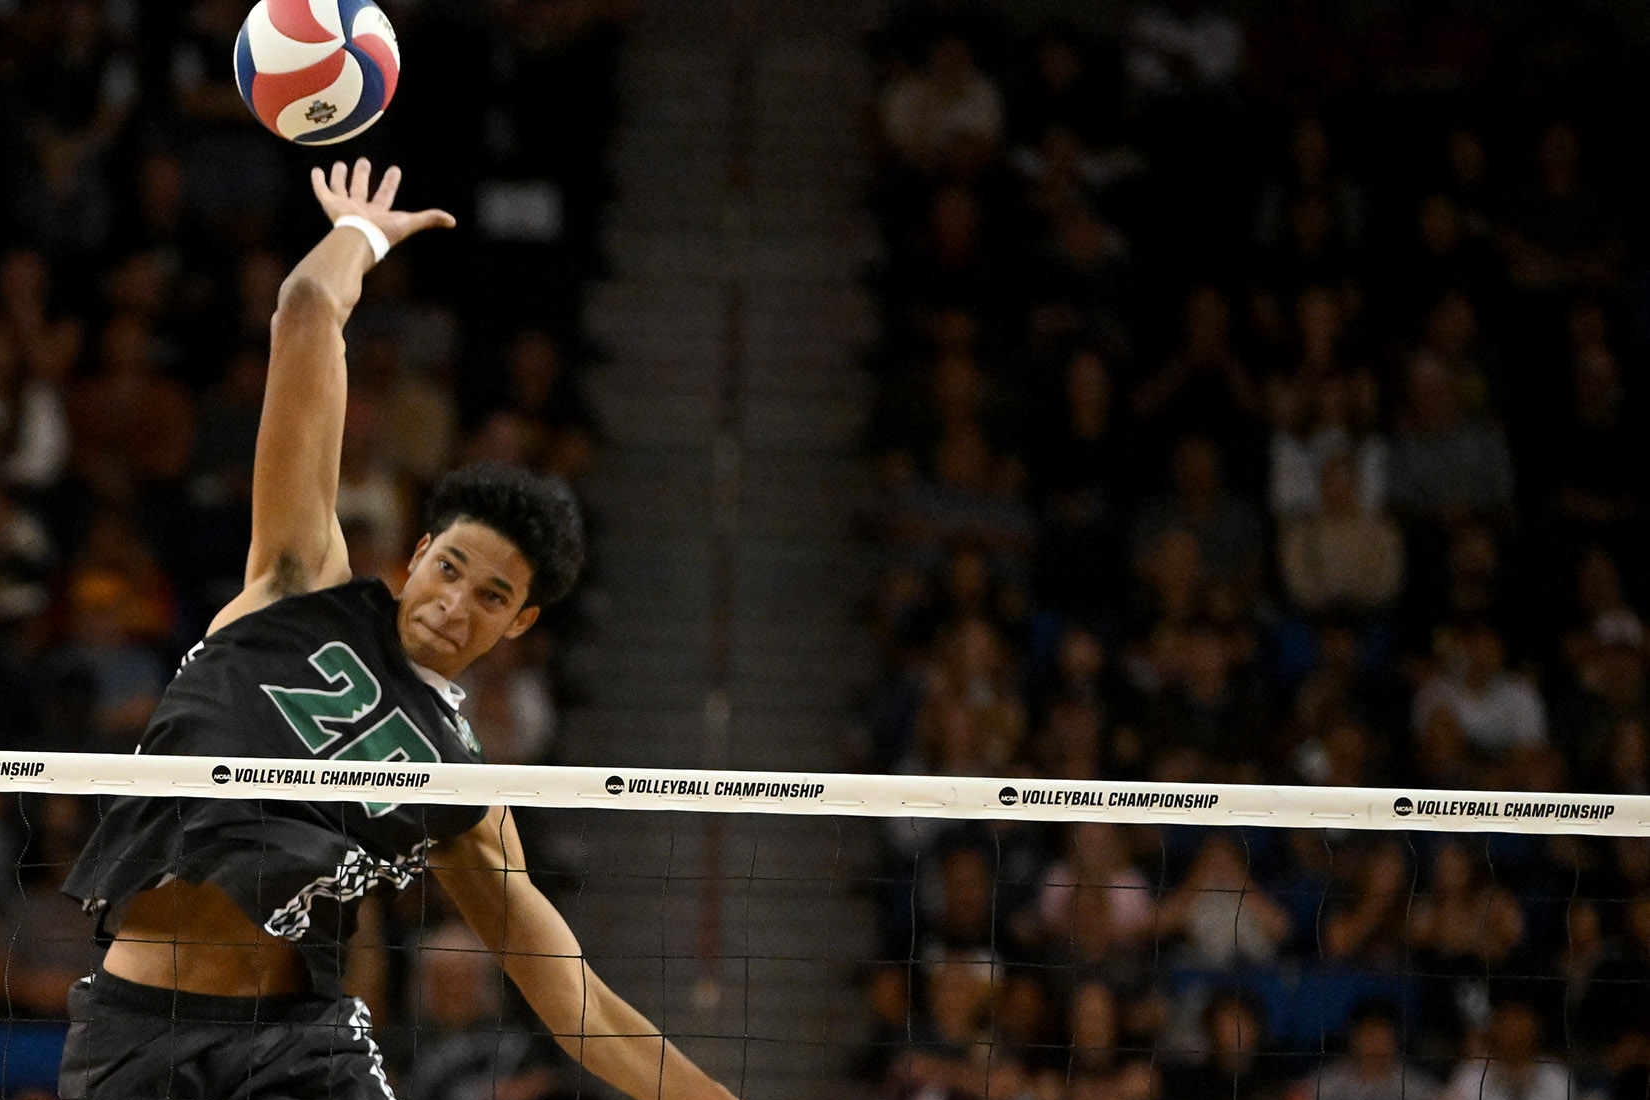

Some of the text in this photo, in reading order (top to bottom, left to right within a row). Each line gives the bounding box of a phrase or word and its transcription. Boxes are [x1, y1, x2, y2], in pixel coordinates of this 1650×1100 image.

[234, 768, 316, 785] VOLLEYBALL
[320, 770, 431, 788] CHAMPIONSHIP
[628, 778, 710, 796] VOLLEYBALL
[714, 781, 825, 798] CHAMPIONSHIP
[1022, 789, 1104, 807] VOLLEYBALL
[1108, 792, 1219, 809] CHAMPIONSHIP
[1417, 800, 1500, 817] VOLLEYBALL
[1503, 802, 1615, 820] CHAMPIONSHIP
